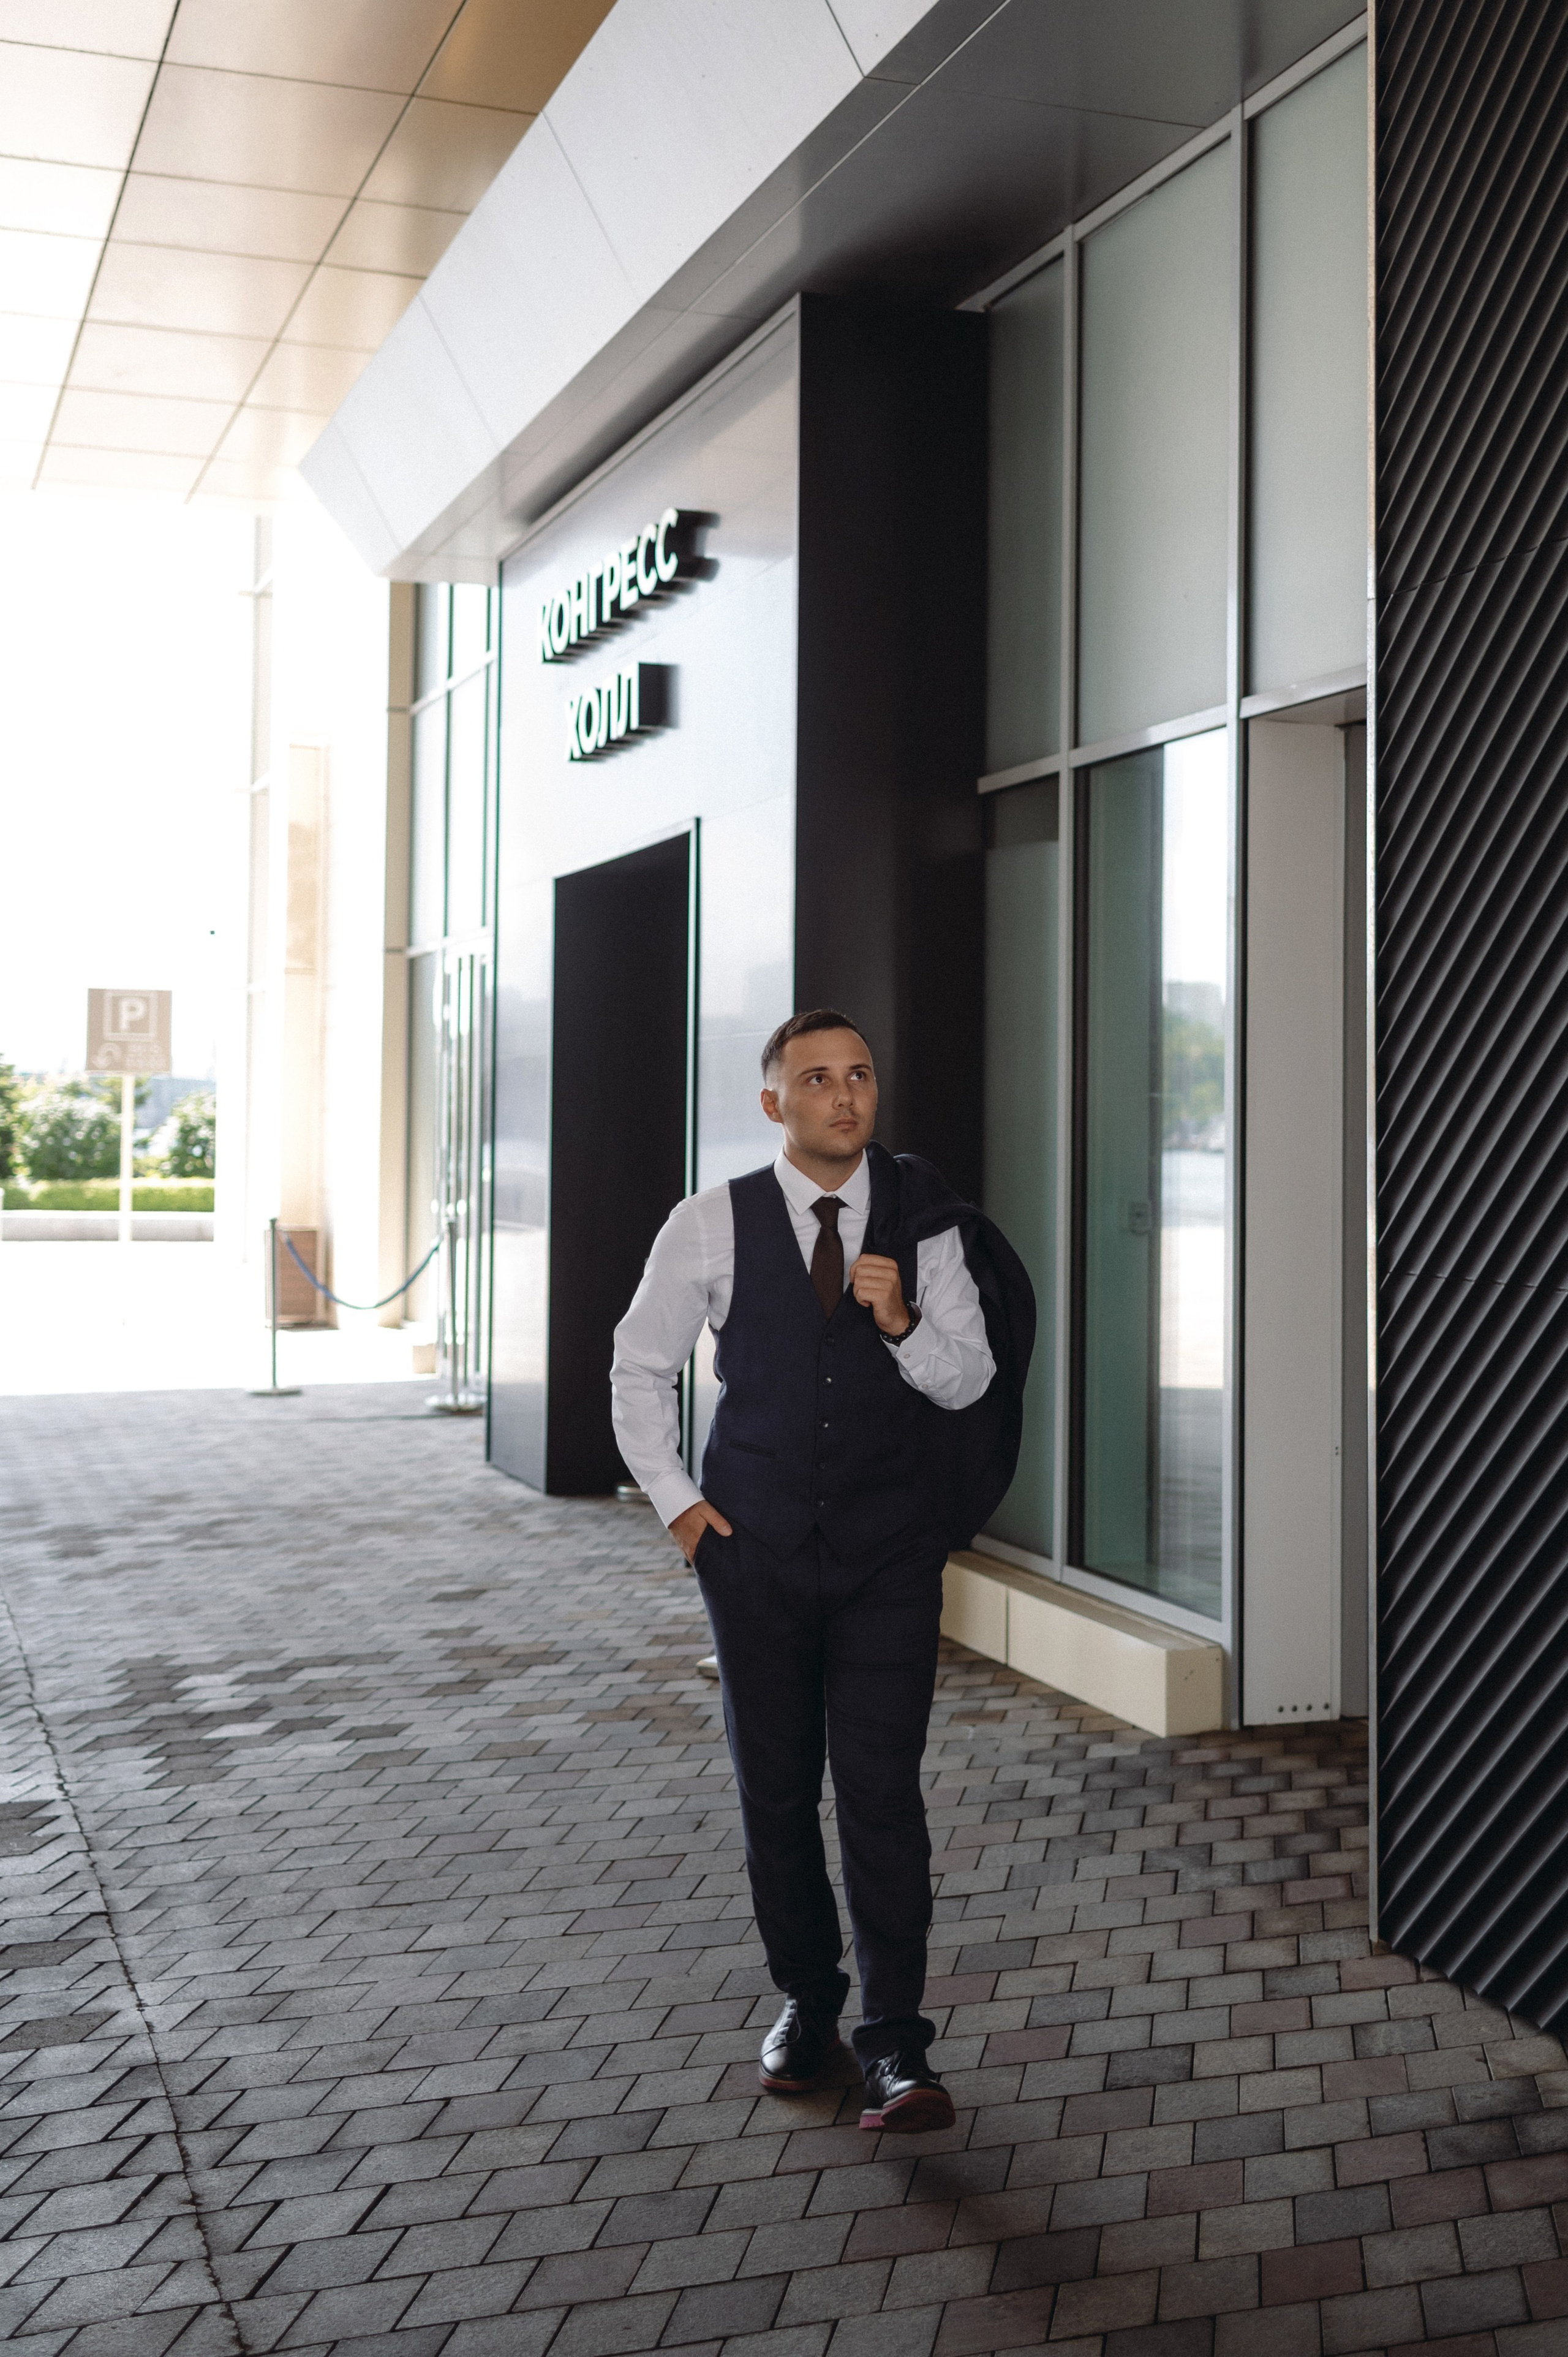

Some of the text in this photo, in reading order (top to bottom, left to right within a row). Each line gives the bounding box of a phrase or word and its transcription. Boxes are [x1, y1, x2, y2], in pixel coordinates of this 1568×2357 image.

[537, 507, 679, 663] КОНГРЕСС
[564, 662, 639, 762] ХОЛЛ
[119, 997, 148, 1031] P
